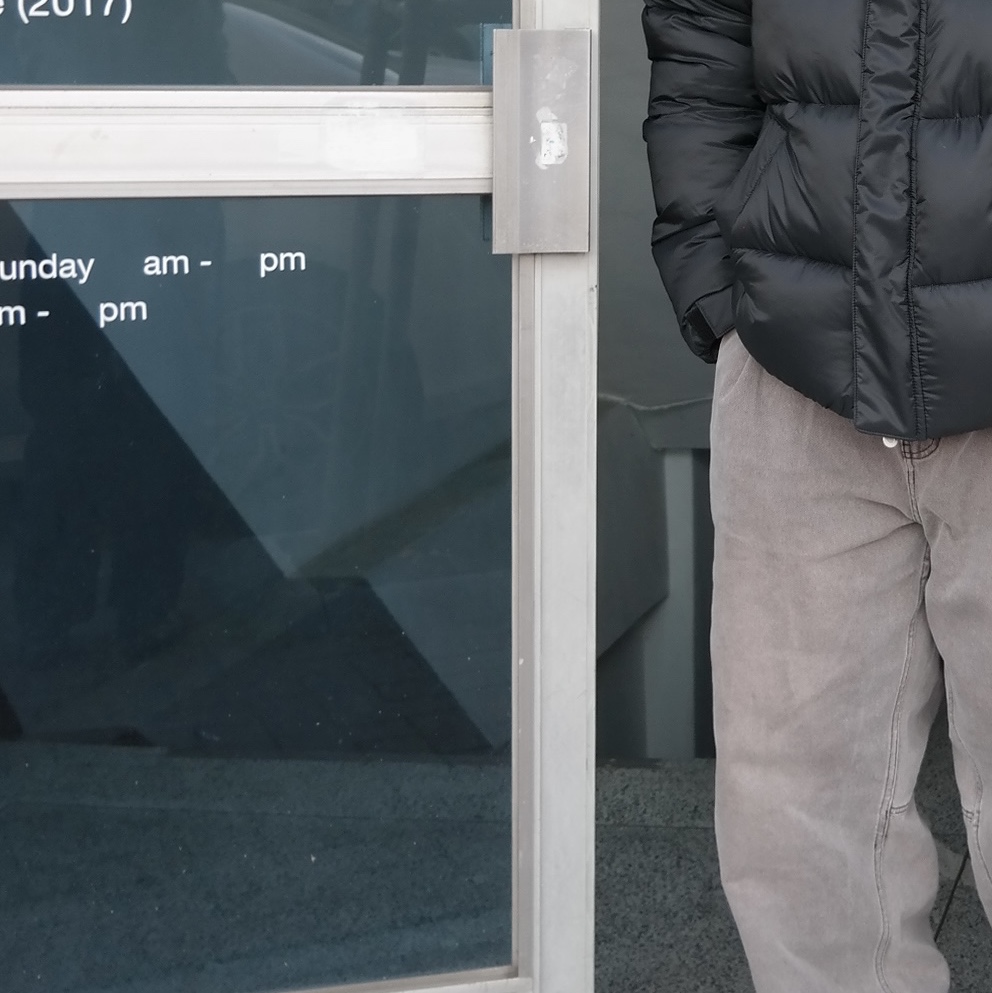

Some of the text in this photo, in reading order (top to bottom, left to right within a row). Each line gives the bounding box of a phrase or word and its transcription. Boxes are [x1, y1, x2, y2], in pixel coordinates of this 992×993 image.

[143, 254, 189, 275] am
[260, 251, 306, 278] pm
[99, 300, 147, 328] pm
